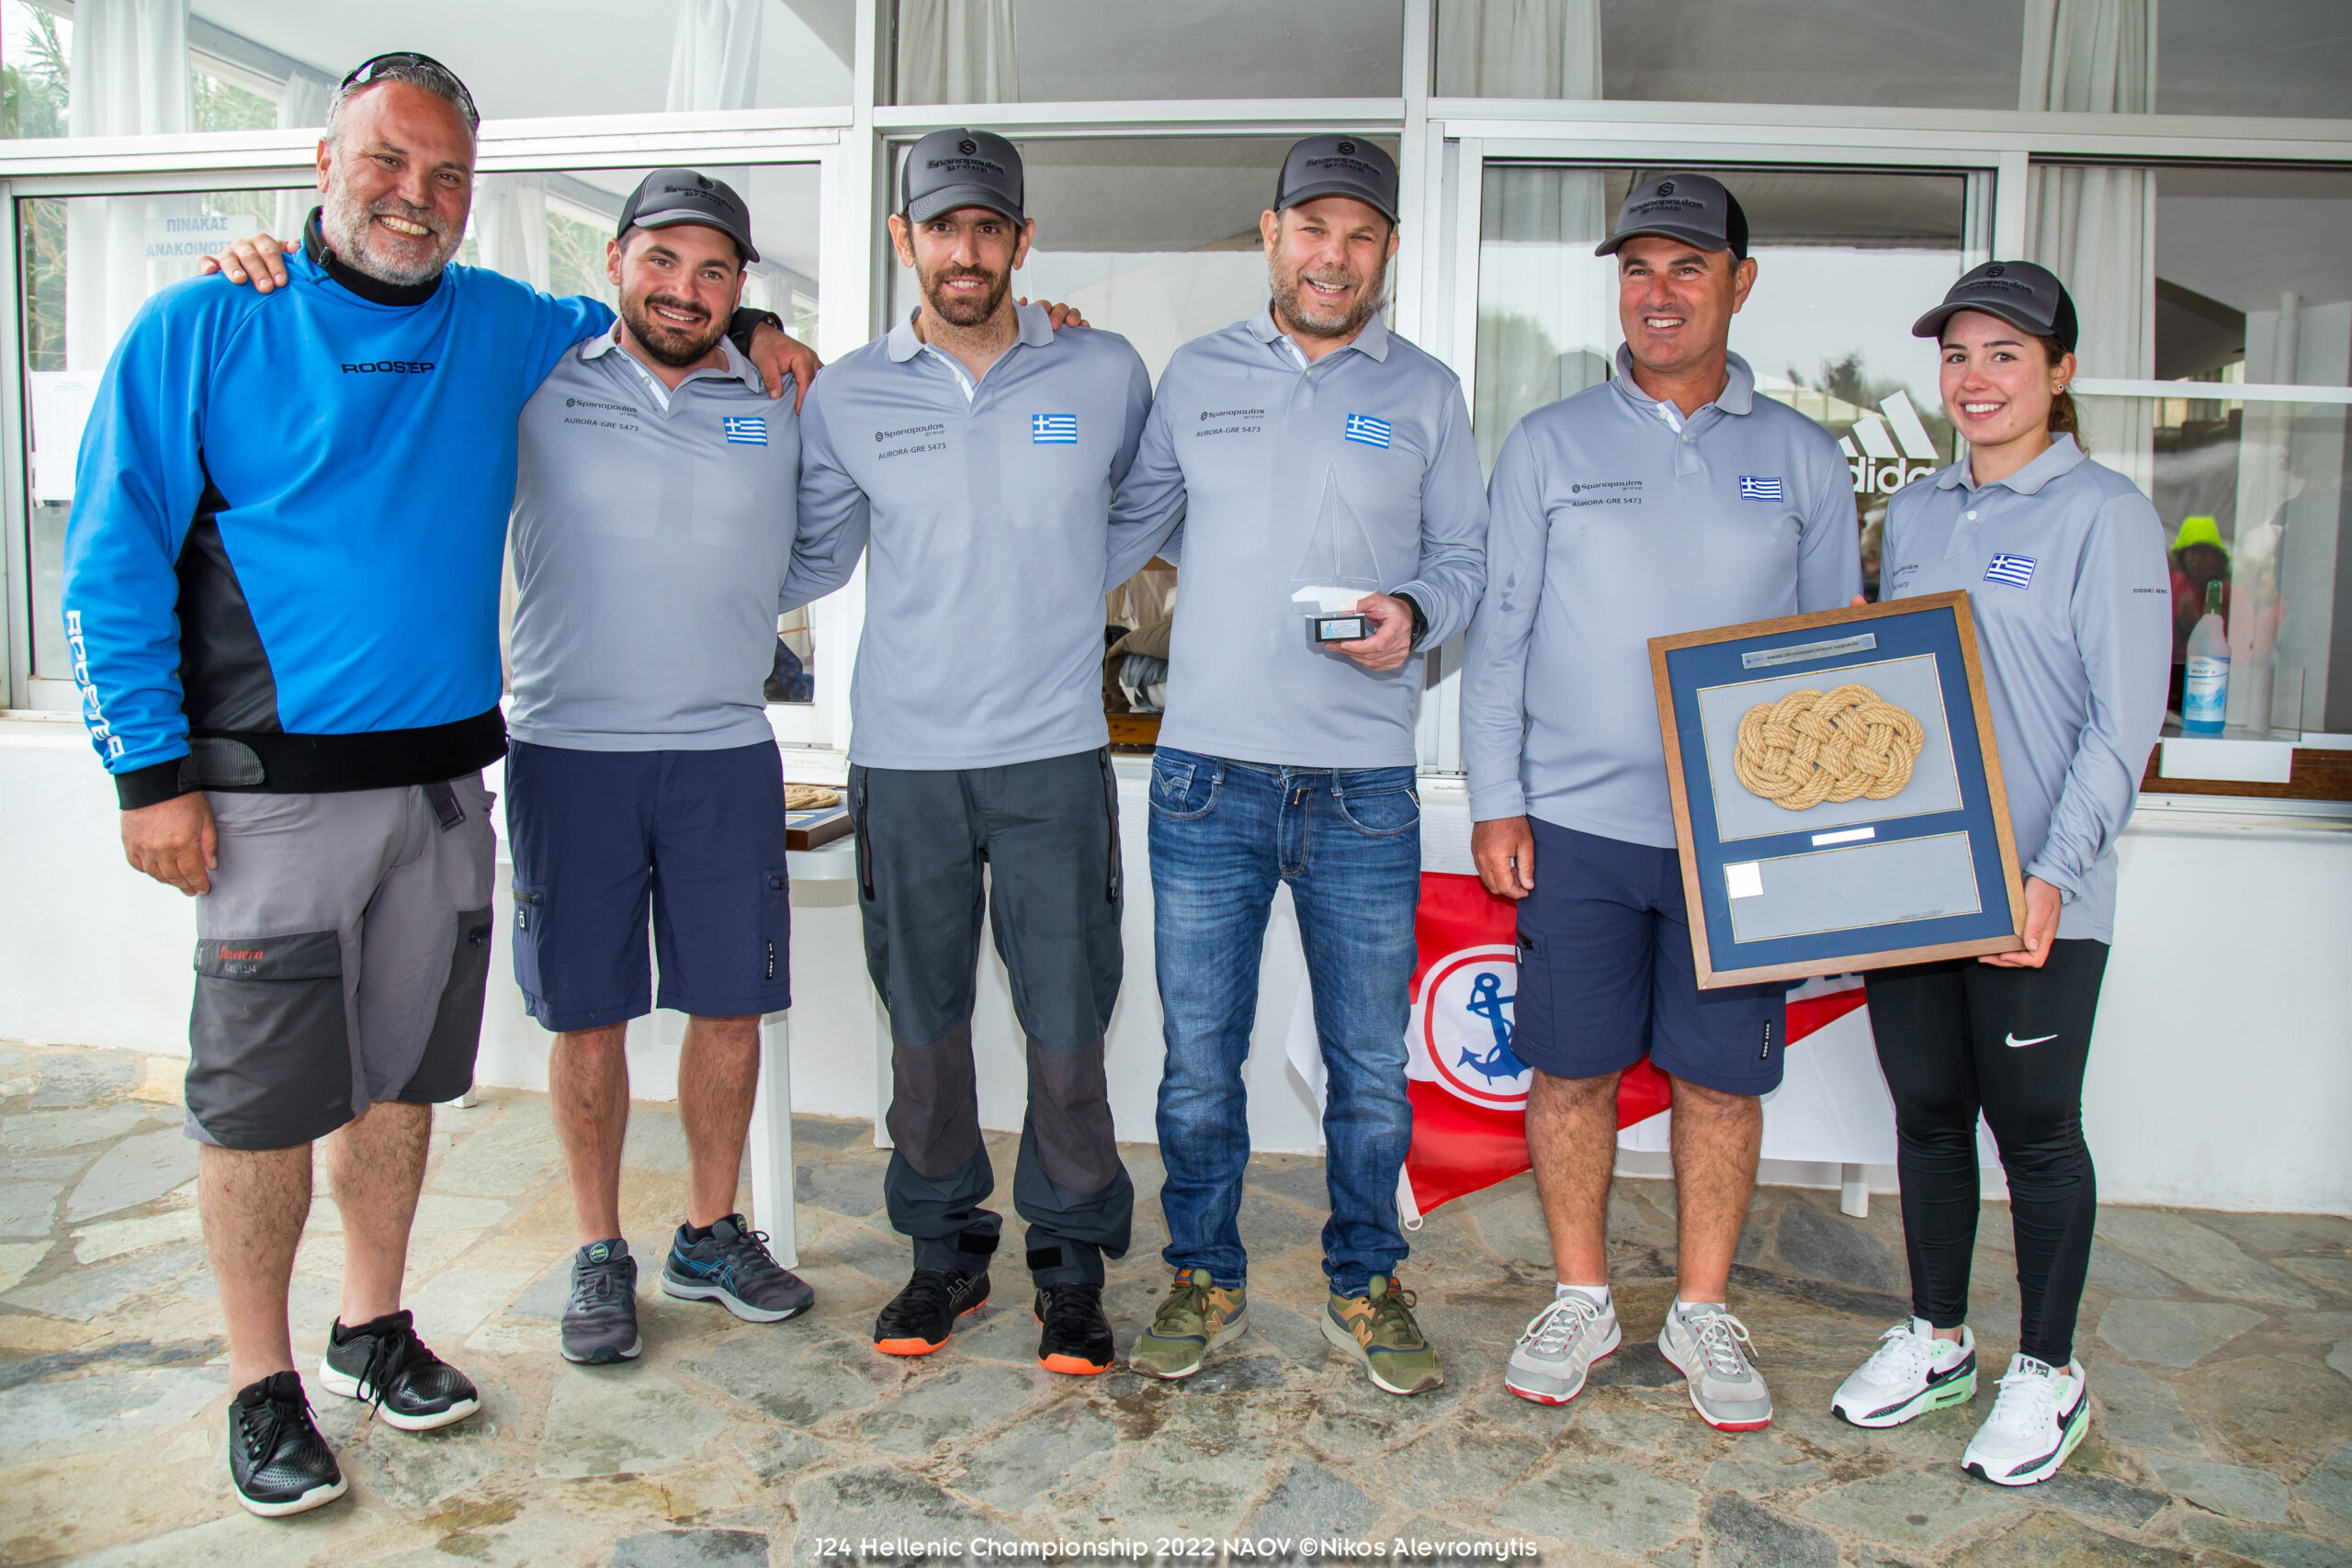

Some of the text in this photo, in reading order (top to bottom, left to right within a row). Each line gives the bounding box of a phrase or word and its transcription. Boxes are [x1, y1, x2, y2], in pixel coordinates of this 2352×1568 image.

[166, 217, 228, 232] ΠΙΝΑΚΑΣ
[145, 241, 230, 257] ΑΝΑΚΟΙΝΩΣ
[576, 400, 638, 413] Spanopoulos
[1208, 408, 1264, 418] Spanopoulos
[884, 423, 944, 438] Spanopoulos
[928, 442, 946, 452] 5473
[1581, 480, 1643, 491] Spanopoulos
